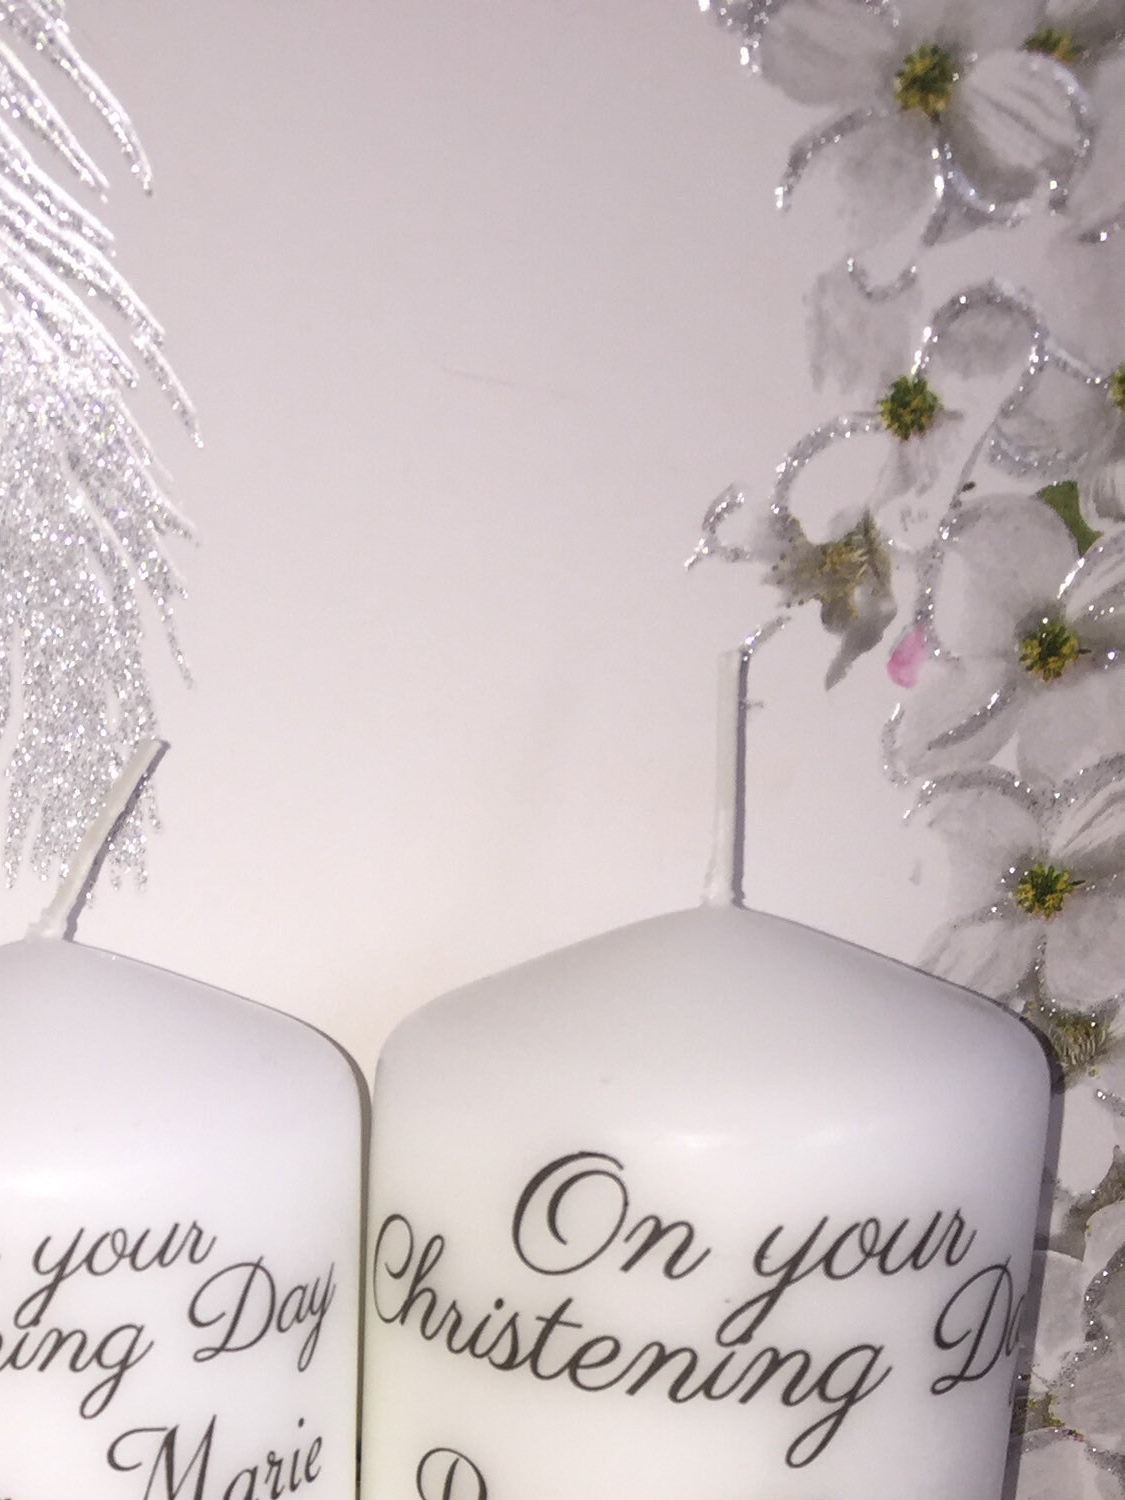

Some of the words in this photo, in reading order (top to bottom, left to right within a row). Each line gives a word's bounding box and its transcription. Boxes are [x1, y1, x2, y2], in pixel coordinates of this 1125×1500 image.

[14, 1220, 216, 1328] your
[188, 1256, 335, 1372] Day
[512, 1151, 710, 1276] On
[717, 1208, 977, 1348] your
[373, 1214, 893, 1468] Christening
[930, 1254, 1026, 1395] Da
